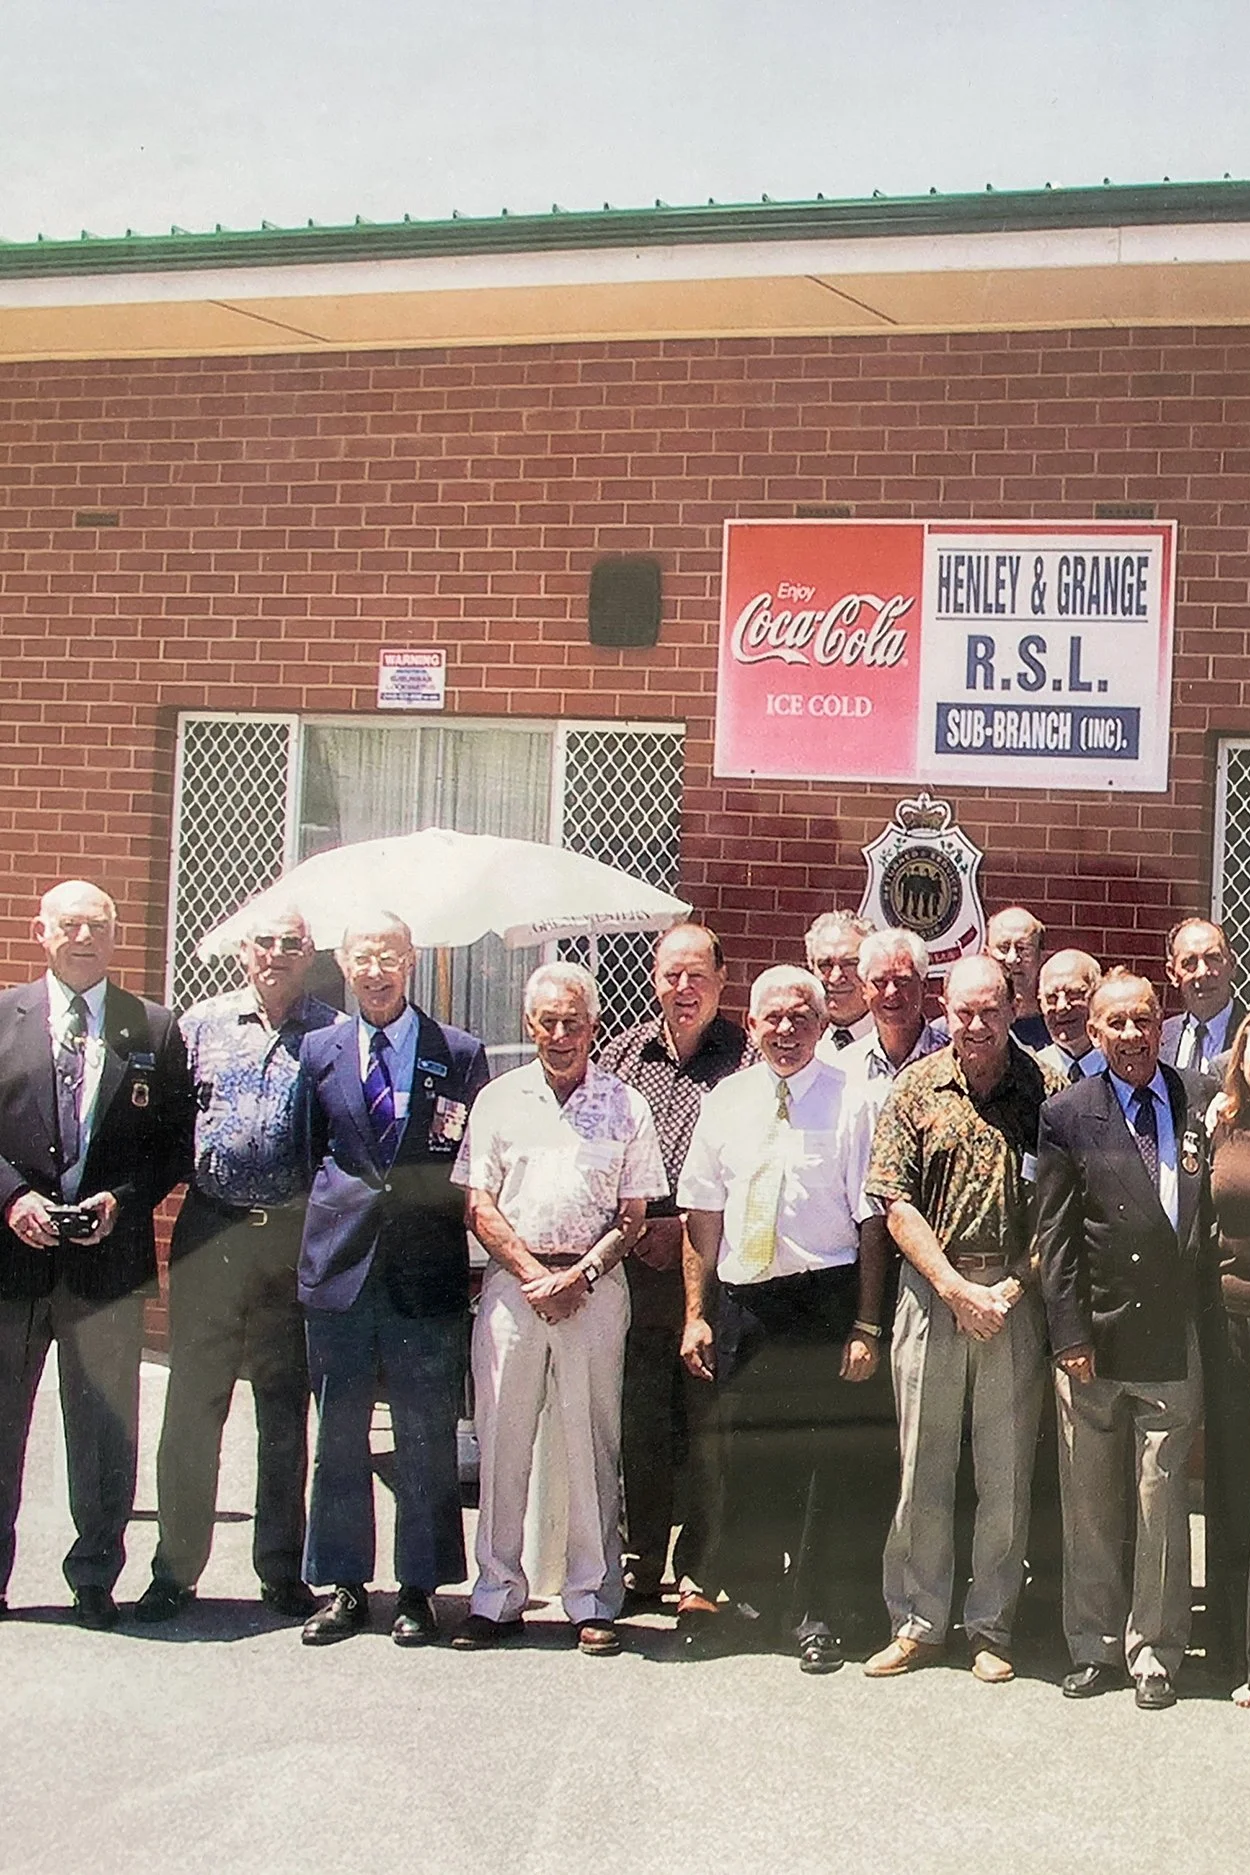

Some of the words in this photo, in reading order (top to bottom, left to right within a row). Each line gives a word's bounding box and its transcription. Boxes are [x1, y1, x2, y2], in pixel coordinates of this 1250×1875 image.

[777, 581, 816, 602] Enjoy
[937, 555, 1021, 614] HENLEY
[1030, 556, 1046, 615] &
[1057, 555, 1149, 616] GRANGE
[731, 593, 915, 668] Coca-Cola
[384, 653, 440, 667] WARNING
[966, 634, 1108, 692] R.S.L.
[766, 694, 803, 716] ICE
[808, 694, 873, 717] COLD
[946, 708, 1072, 750] SUB-BRANCH
[1079, 717, 1128, 751] (INC).
